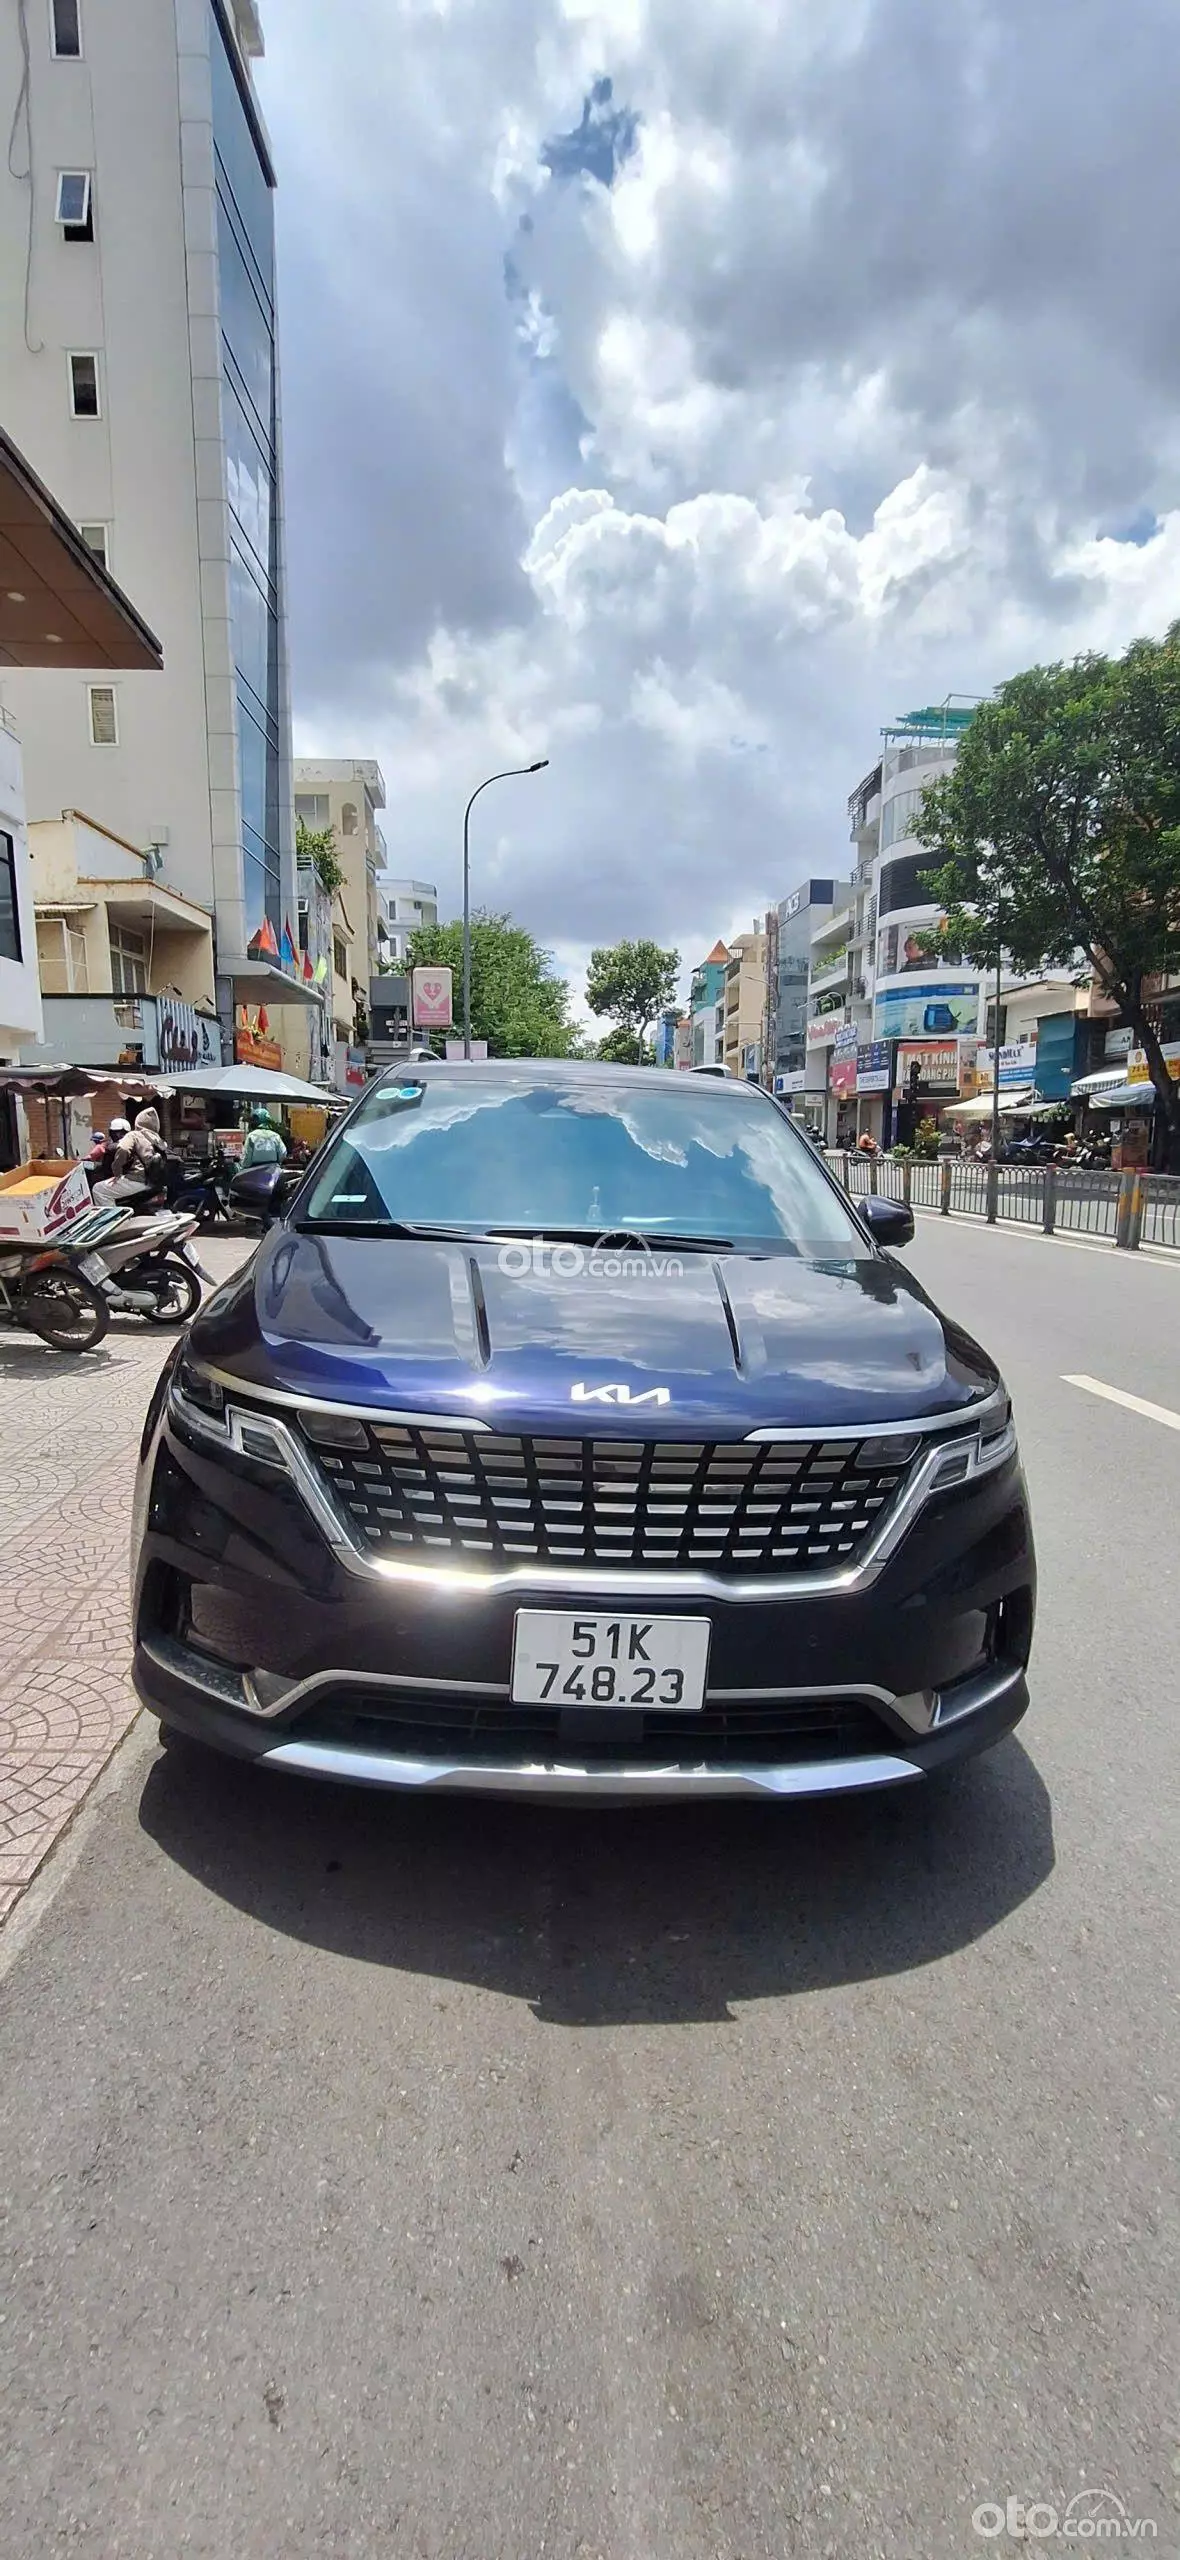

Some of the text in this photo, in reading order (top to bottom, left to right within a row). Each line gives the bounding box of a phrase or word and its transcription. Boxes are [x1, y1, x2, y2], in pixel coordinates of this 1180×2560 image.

[570, 1382, 671, 1406] KIA
[571, 1621, 653, 1661] 51K
[535, 1662, 685, 1704] 748.23
